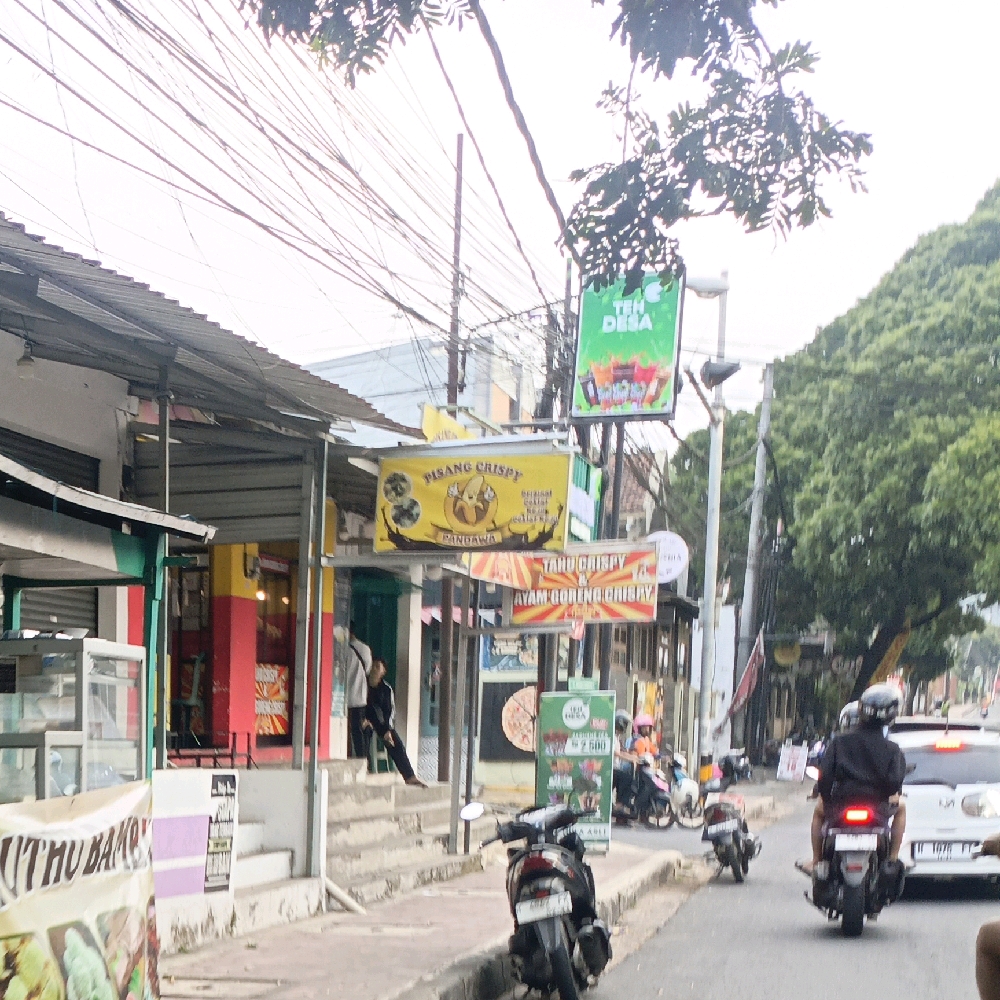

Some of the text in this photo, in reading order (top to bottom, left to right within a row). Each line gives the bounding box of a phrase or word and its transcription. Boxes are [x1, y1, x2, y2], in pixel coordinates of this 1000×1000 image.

[612, 299, 646, 316] TEH
[601, 313, 653, 334] DESA
[422, 461, 523, 484] PISANG CRISPY
[442, 533, 497, 547] PANDAWA
[543, 553, 627, 573] TAHU CRISPY
[514, 584, 654, 605] AYAM GORENG CRISPY
